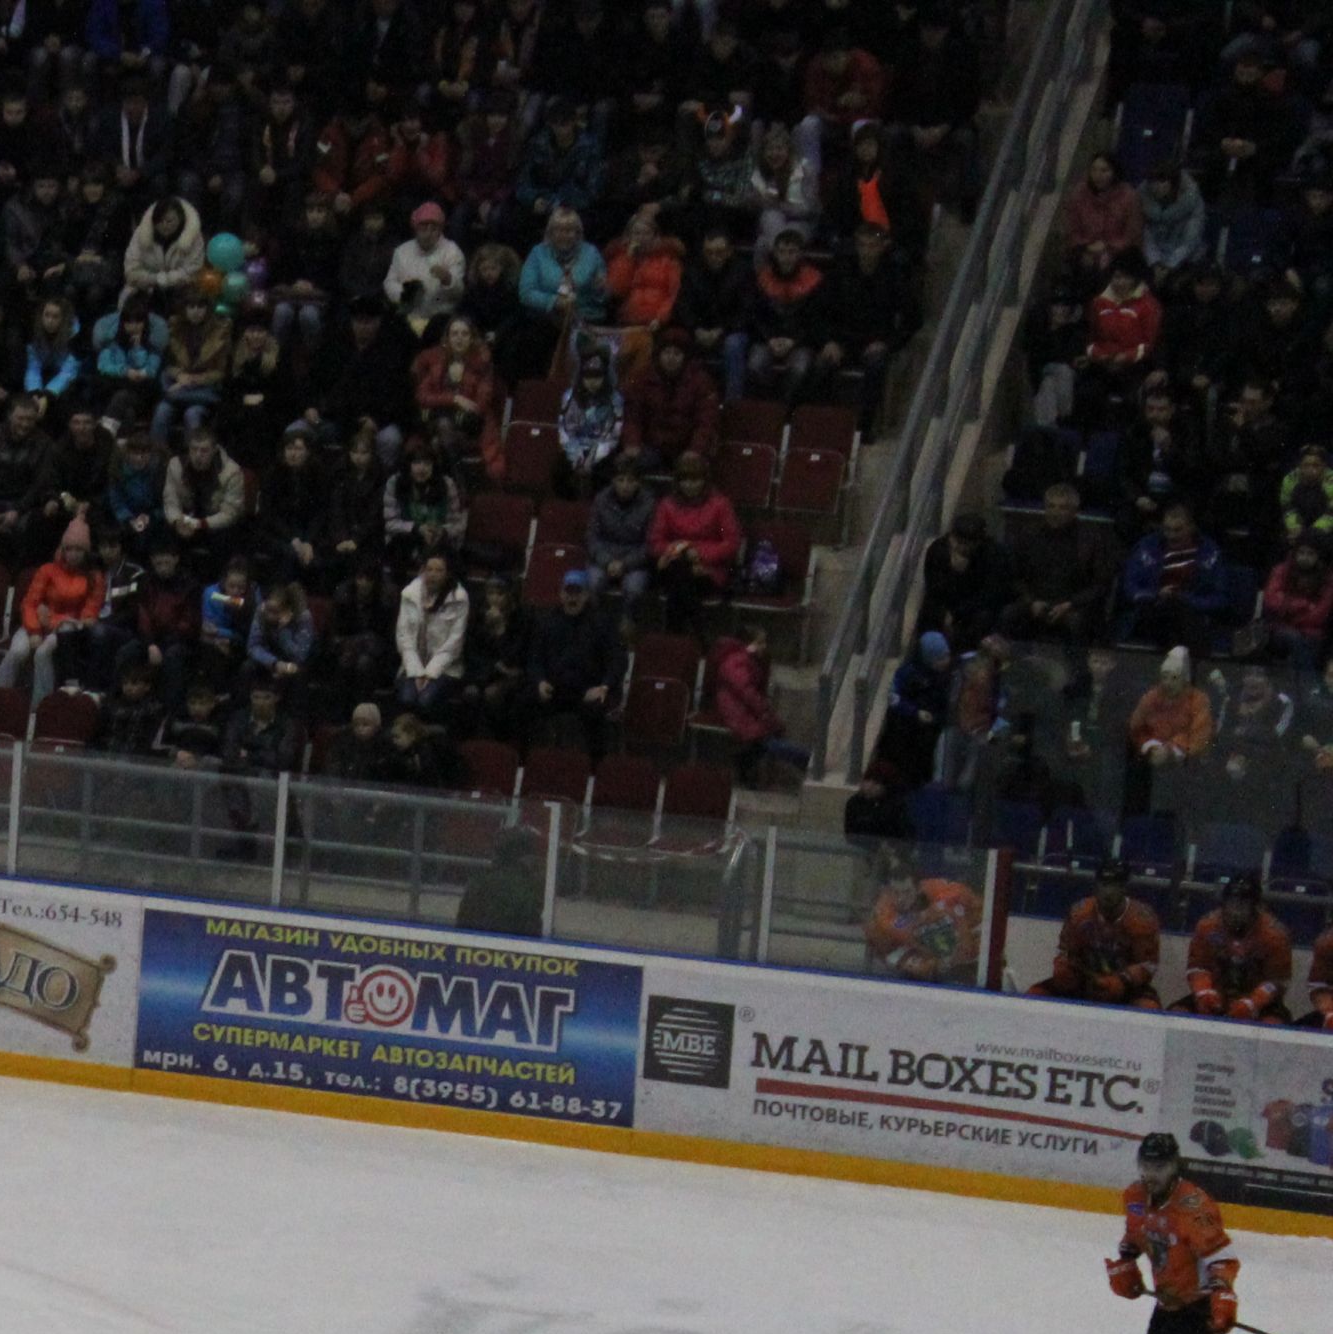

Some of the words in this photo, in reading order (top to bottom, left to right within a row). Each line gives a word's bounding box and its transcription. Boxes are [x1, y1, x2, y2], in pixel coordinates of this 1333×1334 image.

[206, 918, 320, 947] МАГАЗИН
[329, 934, 446, 962] УДОБНЫХ
[456, 949, 578, 977] ПОКУПОК
[193, 1022, 361, 1059] СУПЕРМАРКЕТ
[372, 1044, 576, 1085] АВТОЗАПЧАСТЕЙ
[659, 1031, 717, 1055] MBE
[975, 1042, 1142, 1071] www.mailboxesetc.ru
[213, 1054, 237, 1076] 6,
[324, 1071, 381, 1090] тел.:
[394, 1076, 498, 1109] 8(3955)
[509, 1090, 622, 1119] 61-88-37
[751, 1032, 879, 1082] MAIL
[887, 1049, 1039, 1100] BOXES
[1044, 1066, 1144, 1114] ETC.
[753, 1100, 874, 1130] ПОЧТОВЫЕ,
[879, 1114, 1011, 1145] КУРЬЕРСКИЕ
[1018, 1131, 1098, 1155] УСЛУГИ
